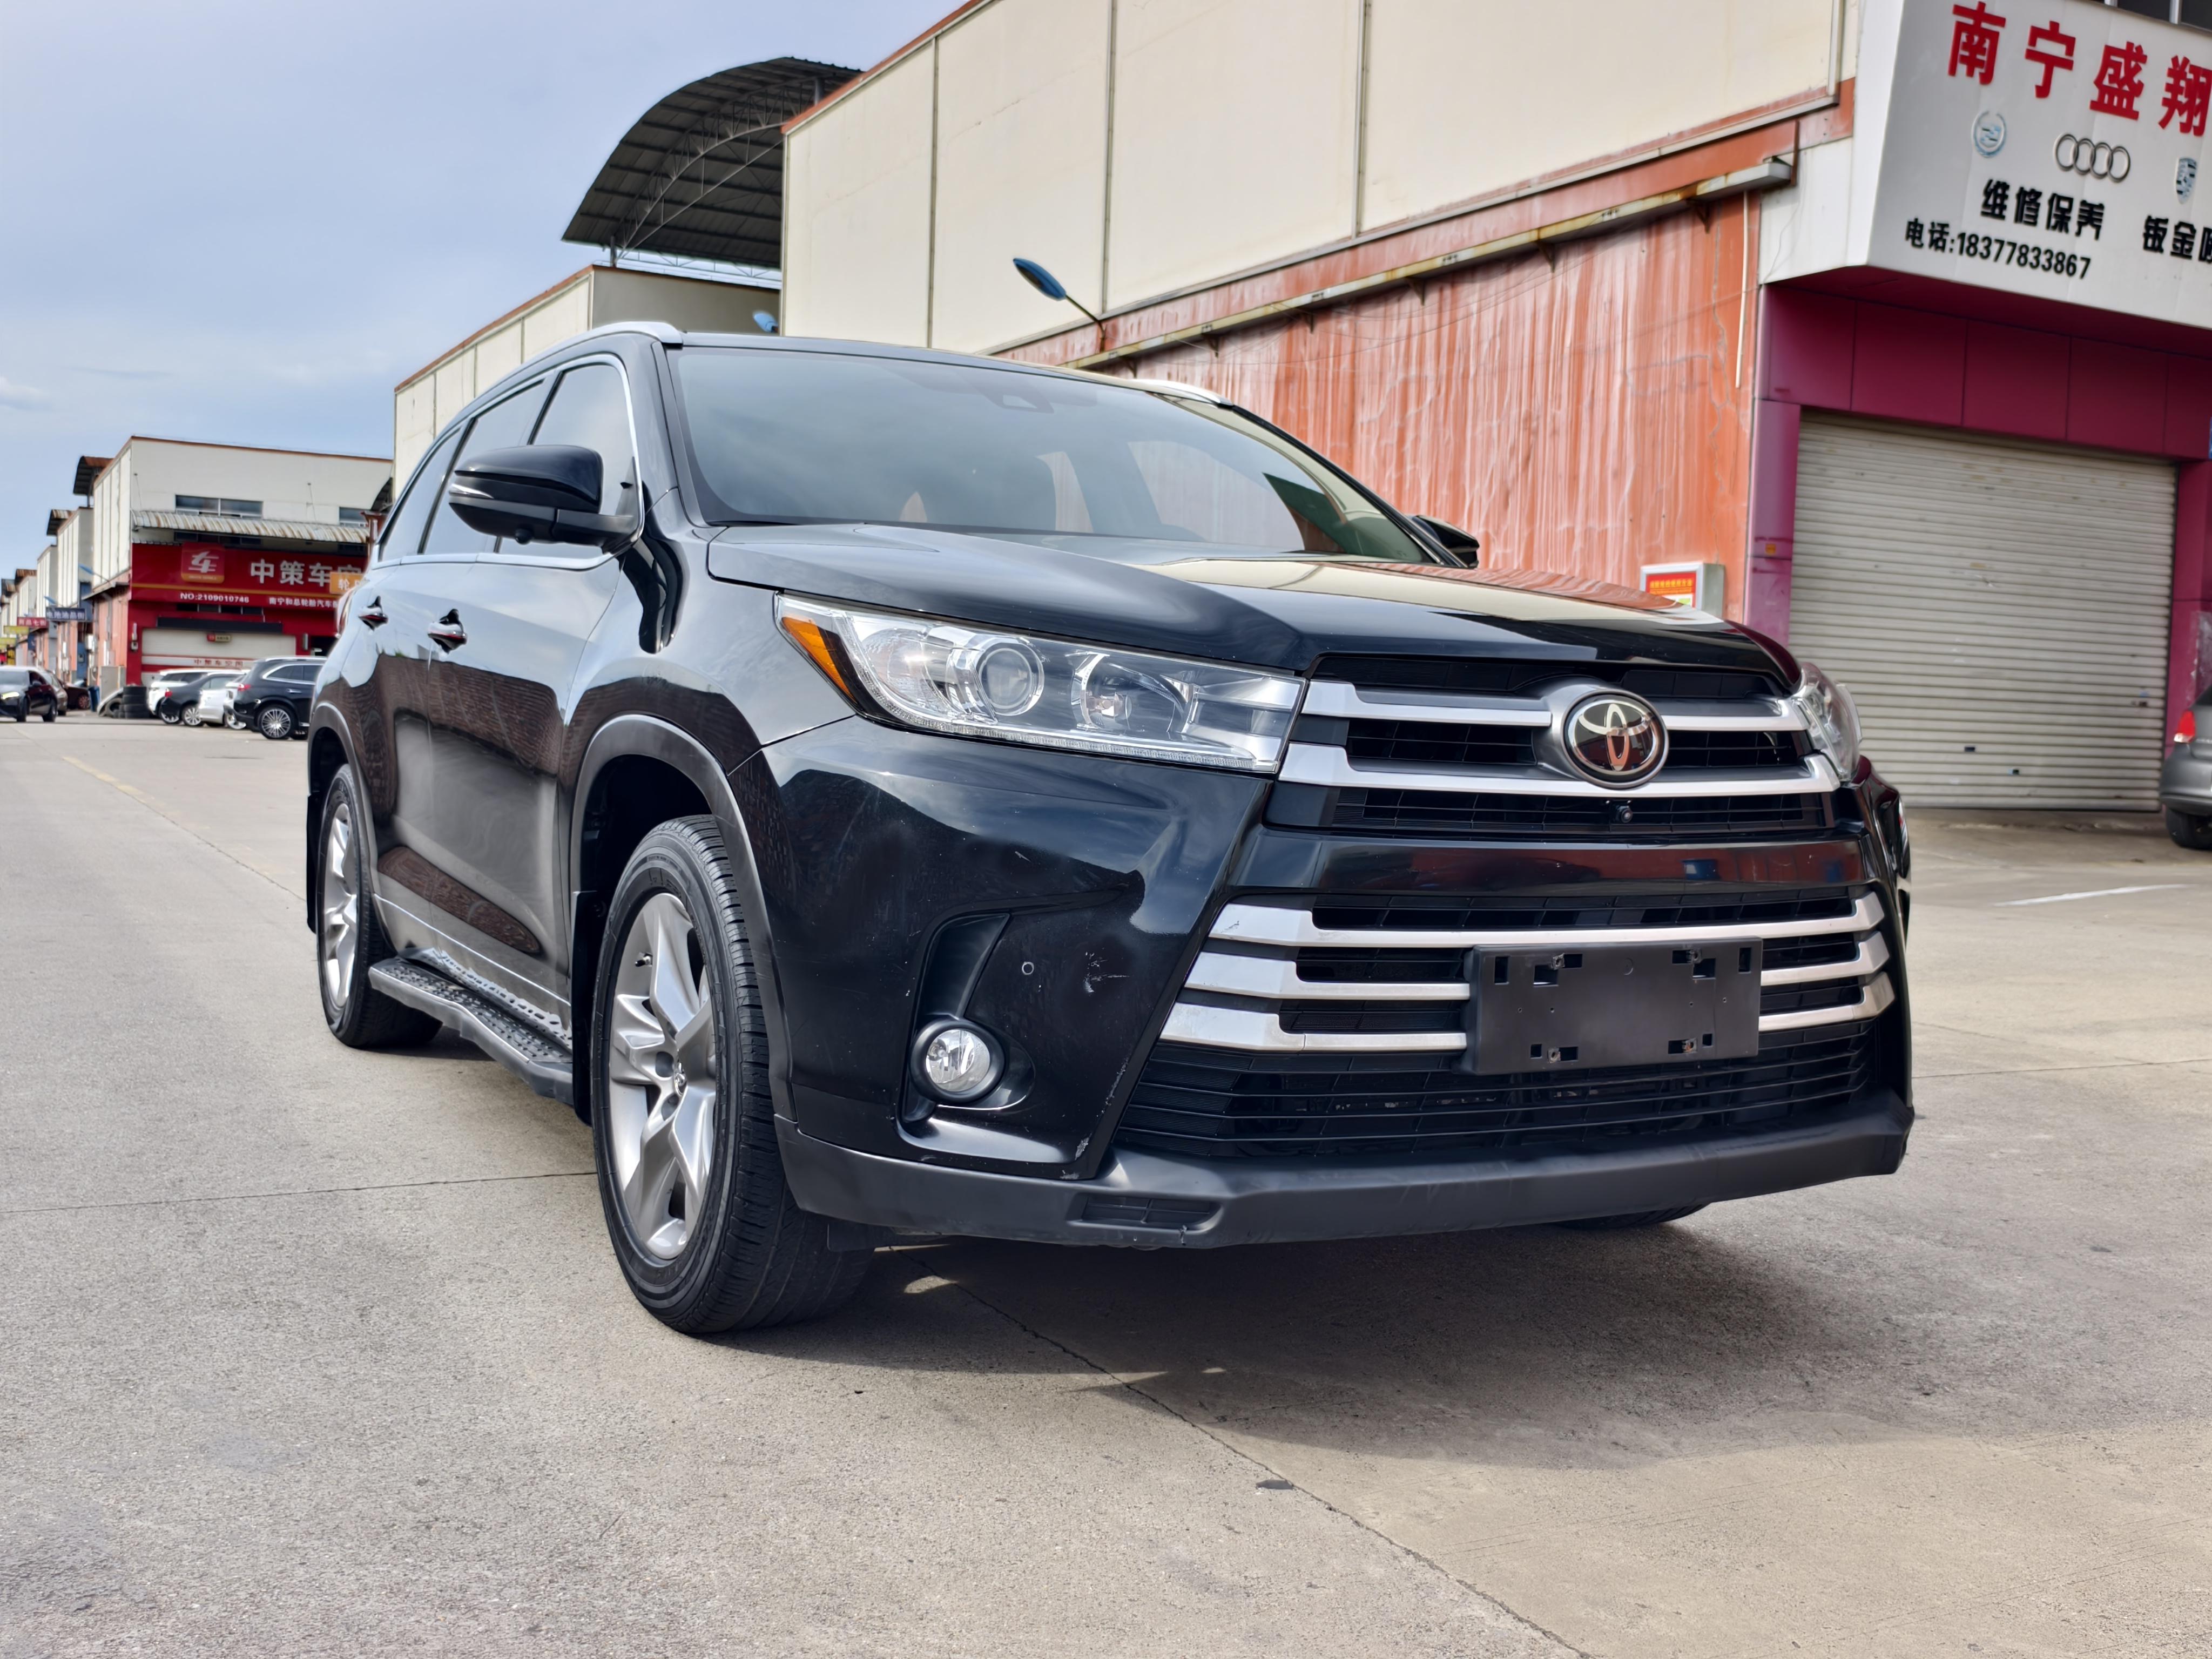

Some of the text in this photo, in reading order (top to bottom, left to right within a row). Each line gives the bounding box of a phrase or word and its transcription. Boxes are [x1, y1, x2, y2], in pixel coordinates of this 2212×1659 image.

[1948, 1, 2212, 137] 南宁盛翔
[1981, 179, 2105, 240] 维修保养
[1905, 218, 2091, 279] 电话:18377833867
